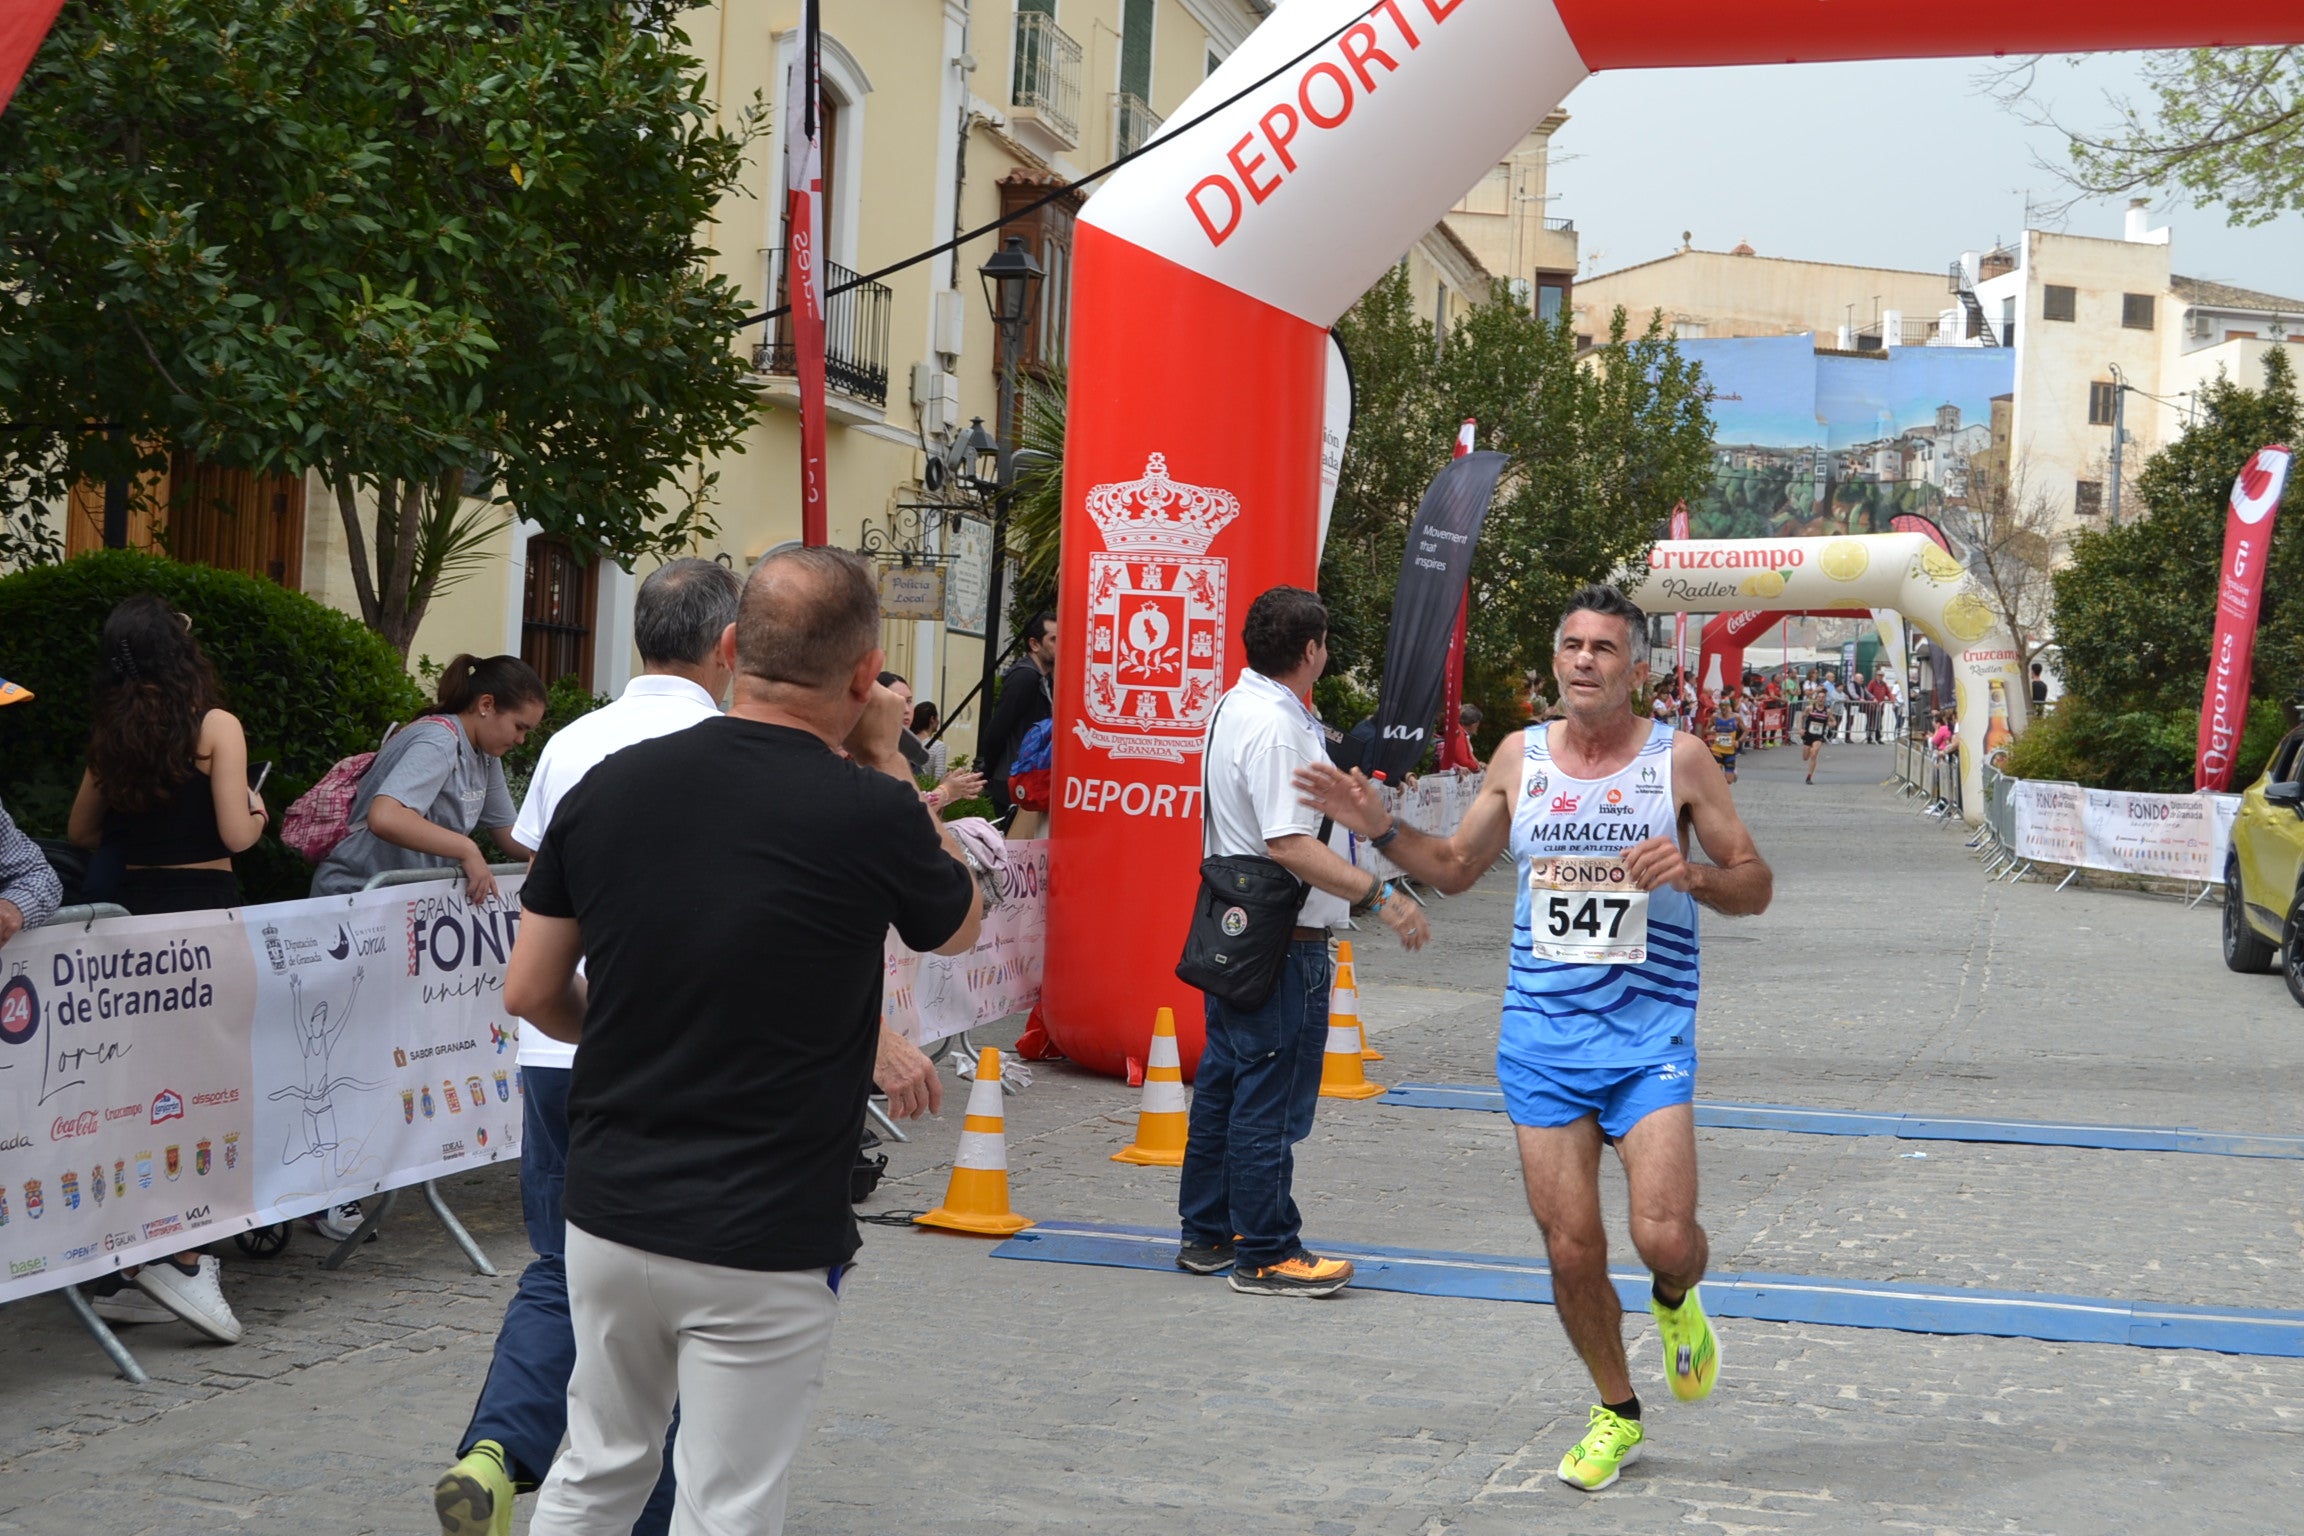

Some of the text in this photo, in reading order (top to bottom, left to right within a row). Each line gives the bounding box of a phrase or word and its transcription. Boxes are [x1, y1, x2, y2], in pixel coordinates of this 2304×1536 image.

[1419, 540, 1437, 552] that
[1423, 524, 1468, 545] Movement
[1415, 555, 1447, 571] inspires
[1648, 546, 1804, 571] Cruzcampo
[1662, 577, 1738, 601] Radler
[2203, 632, 2234, 775] Deportes
[1117, 743, 1173, 756] GRANADA
[1063, 776, 1203, 819] DEPORT
[2131, 801, 2170, 821] FONDO
[1530, 823, 1650, 842] MARACENA
[1555, 866, 1625, 883] FONDO
[413, 894, 463, 922] GRAN
[1548, 896, 1631, 939] 547
[53, 939, 212, 993] Diputación
[3, 994, 29, 1024] 24
[57, 977, 213, 1026] de Granada
[410, 1039, 477, 1061] SABOR GRANADA
